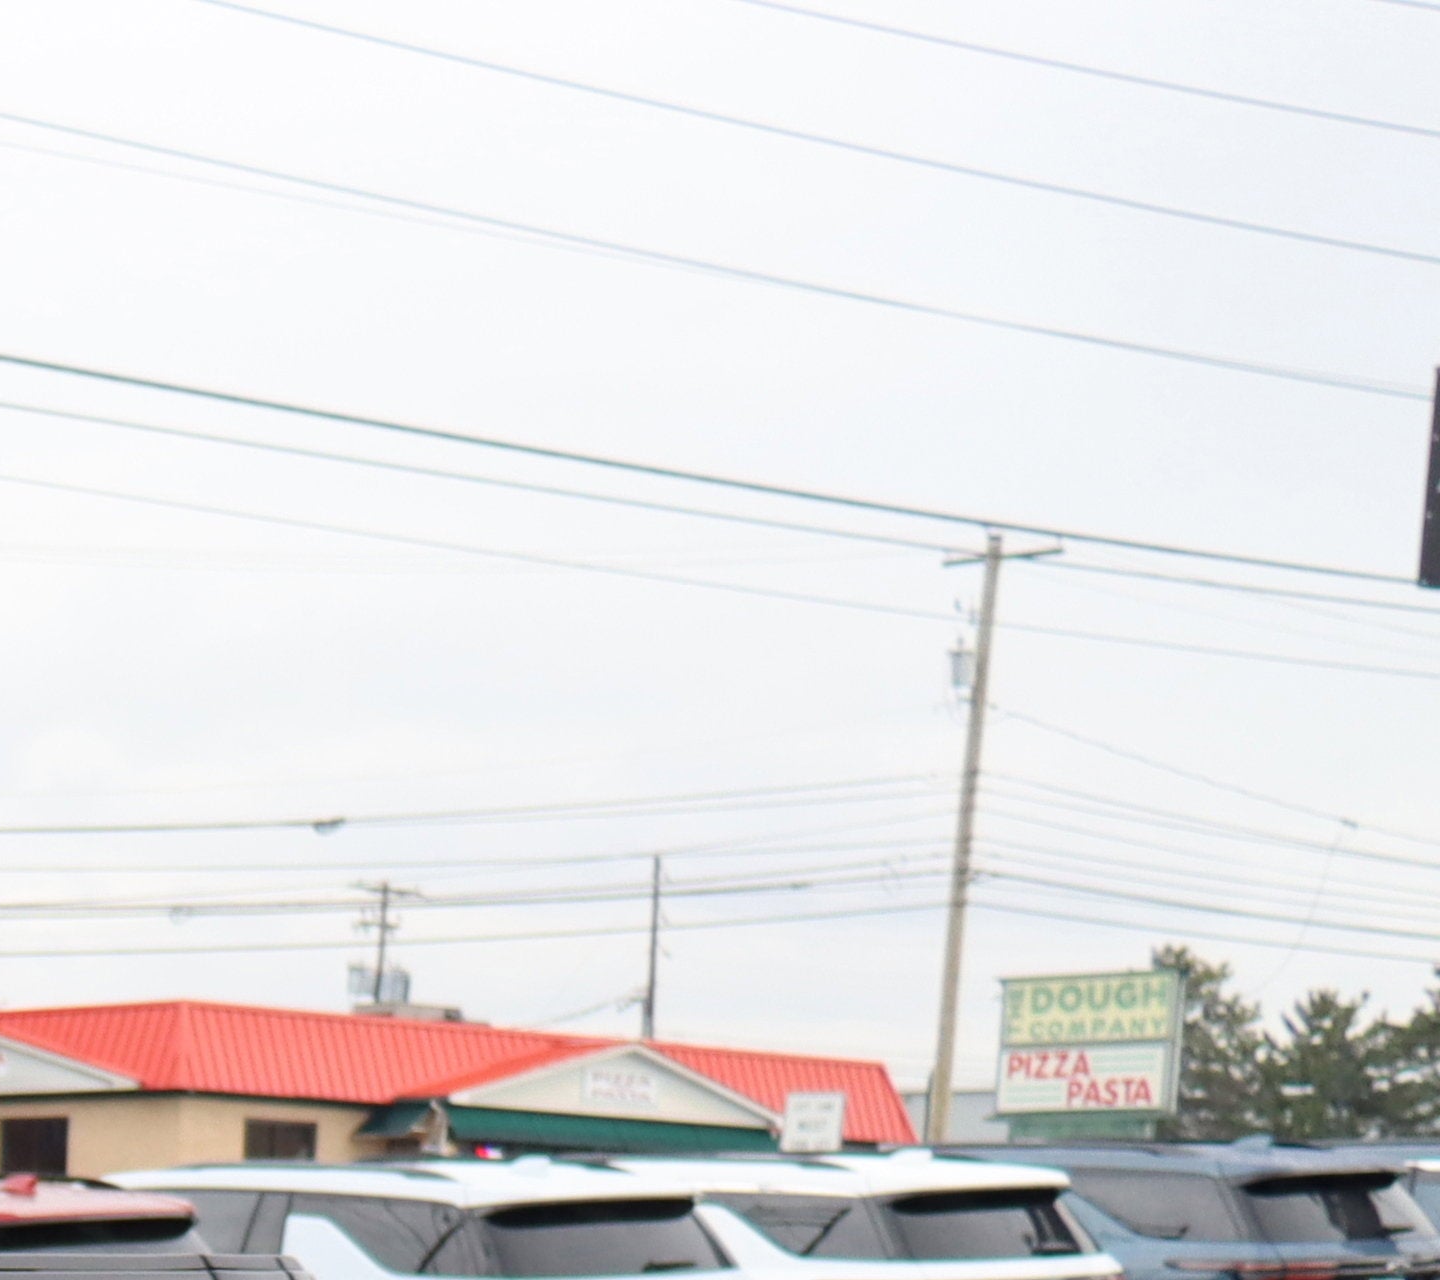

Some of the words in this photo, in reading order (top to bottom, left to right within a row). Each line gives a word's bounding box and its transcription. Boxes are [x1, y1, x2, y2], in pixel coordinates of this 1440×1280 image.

[1030, 980, 1168, 1015] DOUGH
[1029, 1017, 1166, 1038] COMPANY
[1007, 1050, 1091, 1080] PIZZA
[1066, 1078, 1152, 1107] PASTA
